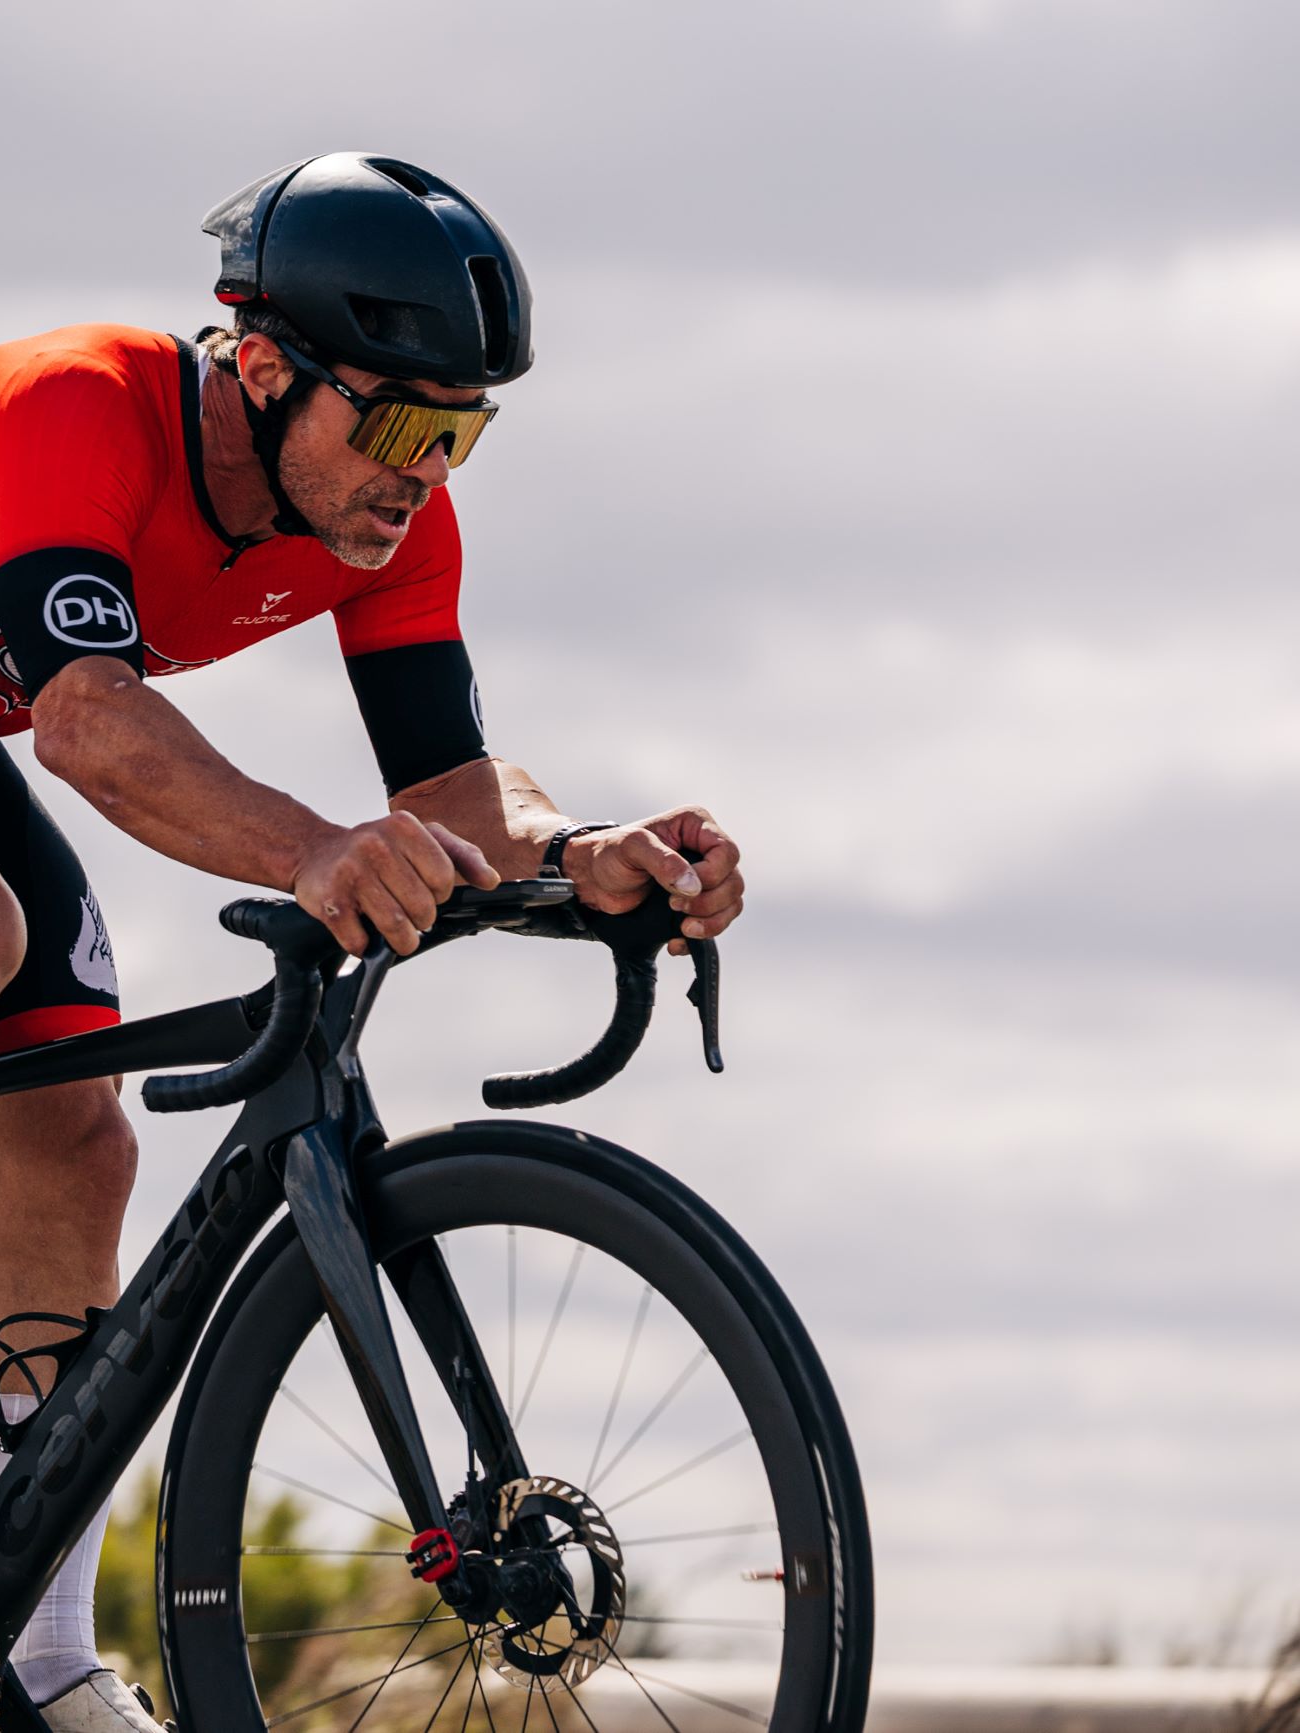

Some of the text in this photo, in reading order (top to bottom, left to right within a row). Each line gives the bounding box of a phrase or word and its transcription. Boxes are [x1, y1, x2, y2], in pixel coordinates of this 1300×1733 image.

[53, 596, 130, 632] DH
[231, 613, 292, 625] CUORE
[543, 884, 569, 893] GARMIN
